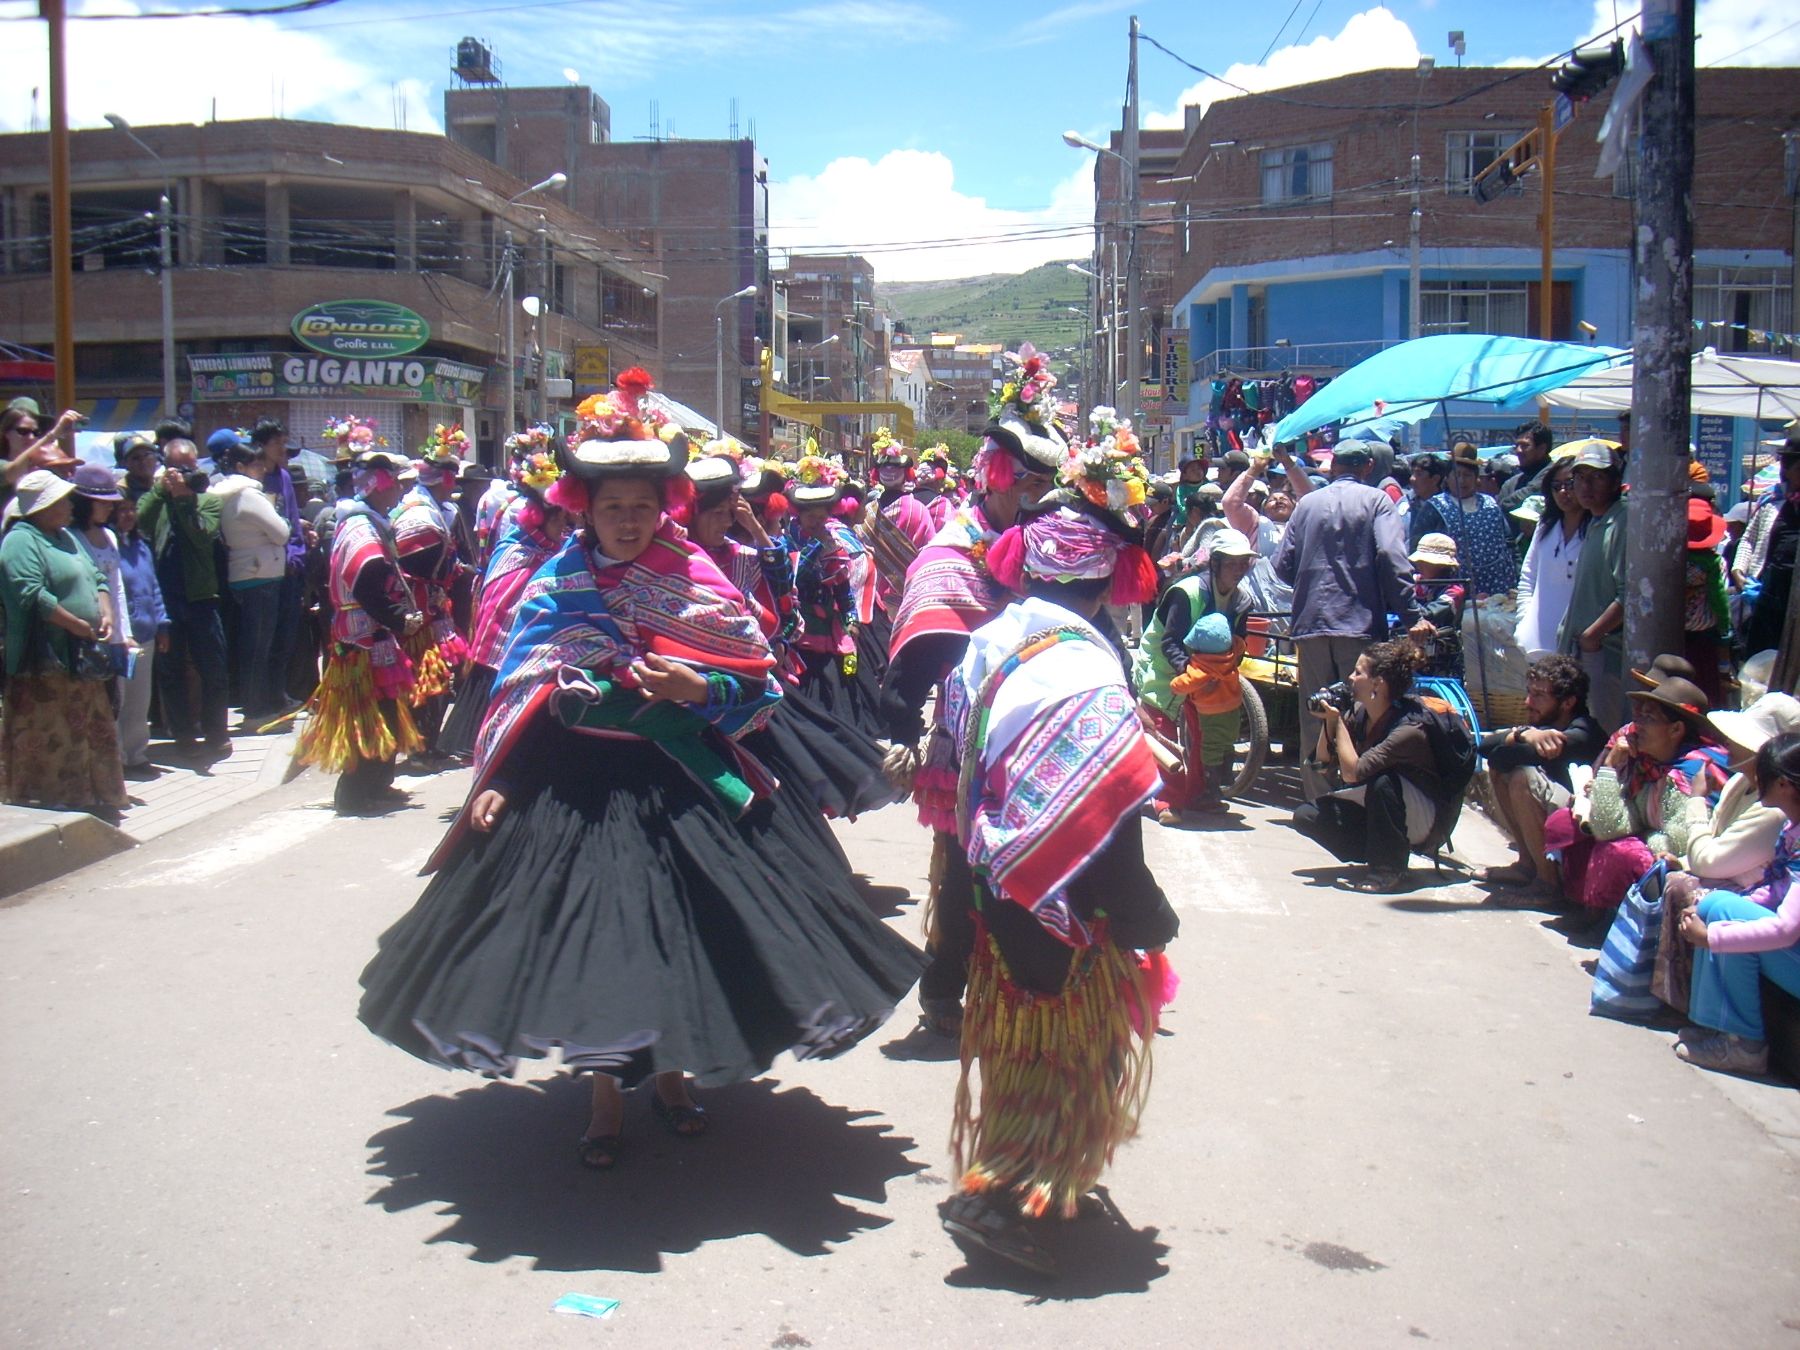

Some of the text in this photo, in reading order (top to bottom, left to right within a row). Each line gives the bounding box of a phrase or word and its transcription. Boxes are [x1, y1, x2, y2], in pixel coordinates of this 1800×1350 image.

[227, 356, 273, 371] LUMINOSOS
[283, 358, 426, 388] GIGANTO
[1165, 337, 1179, 402] LIBRERIA
